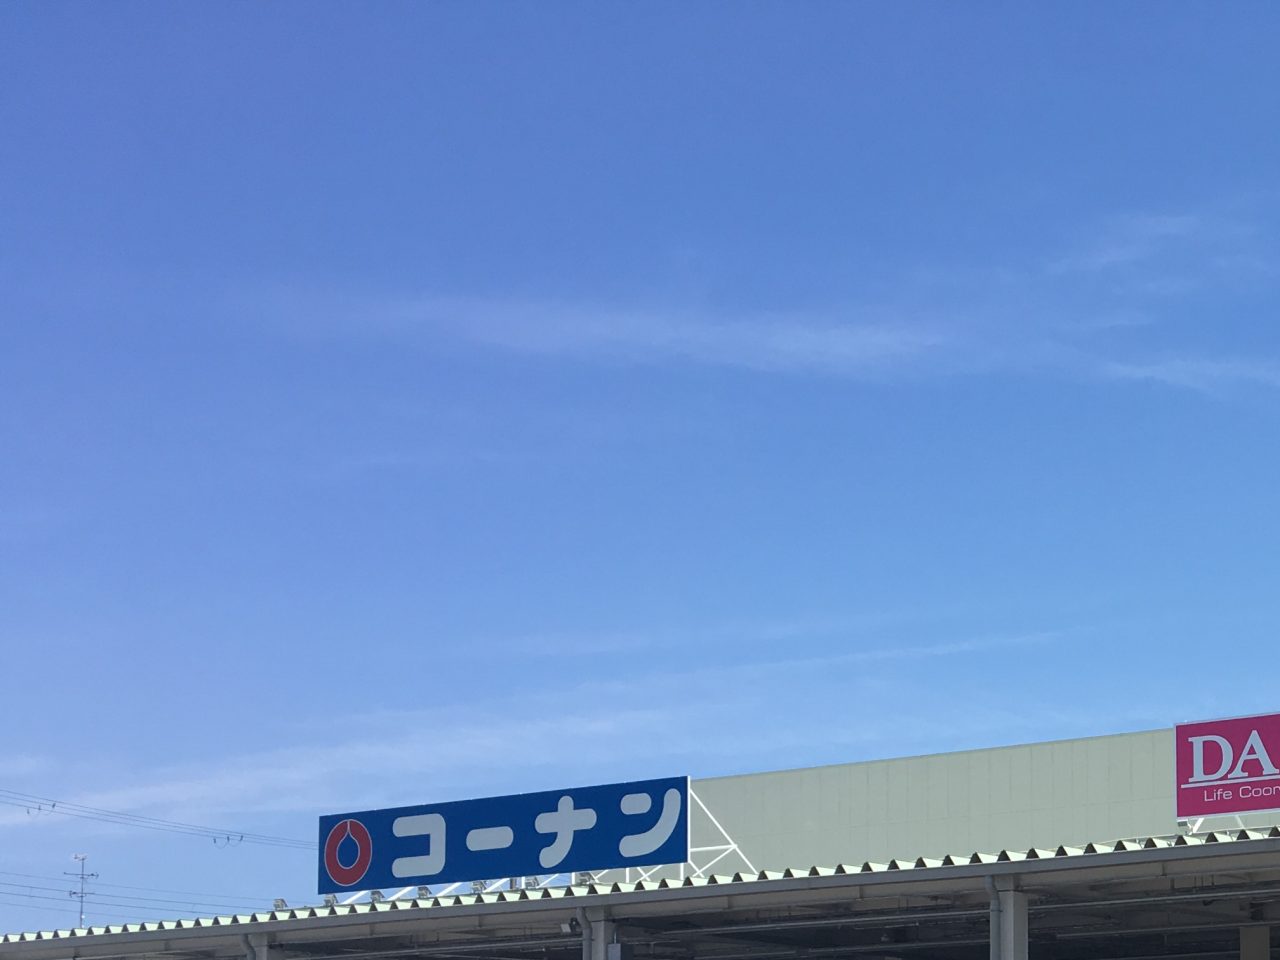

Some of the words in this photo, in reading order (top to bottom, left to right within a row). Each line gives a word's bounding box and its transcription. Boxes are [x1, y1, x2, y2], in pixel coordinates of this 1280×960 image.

[1204, 787, 1233, 802] Life
[391, 788, 681, 878] コーナン
